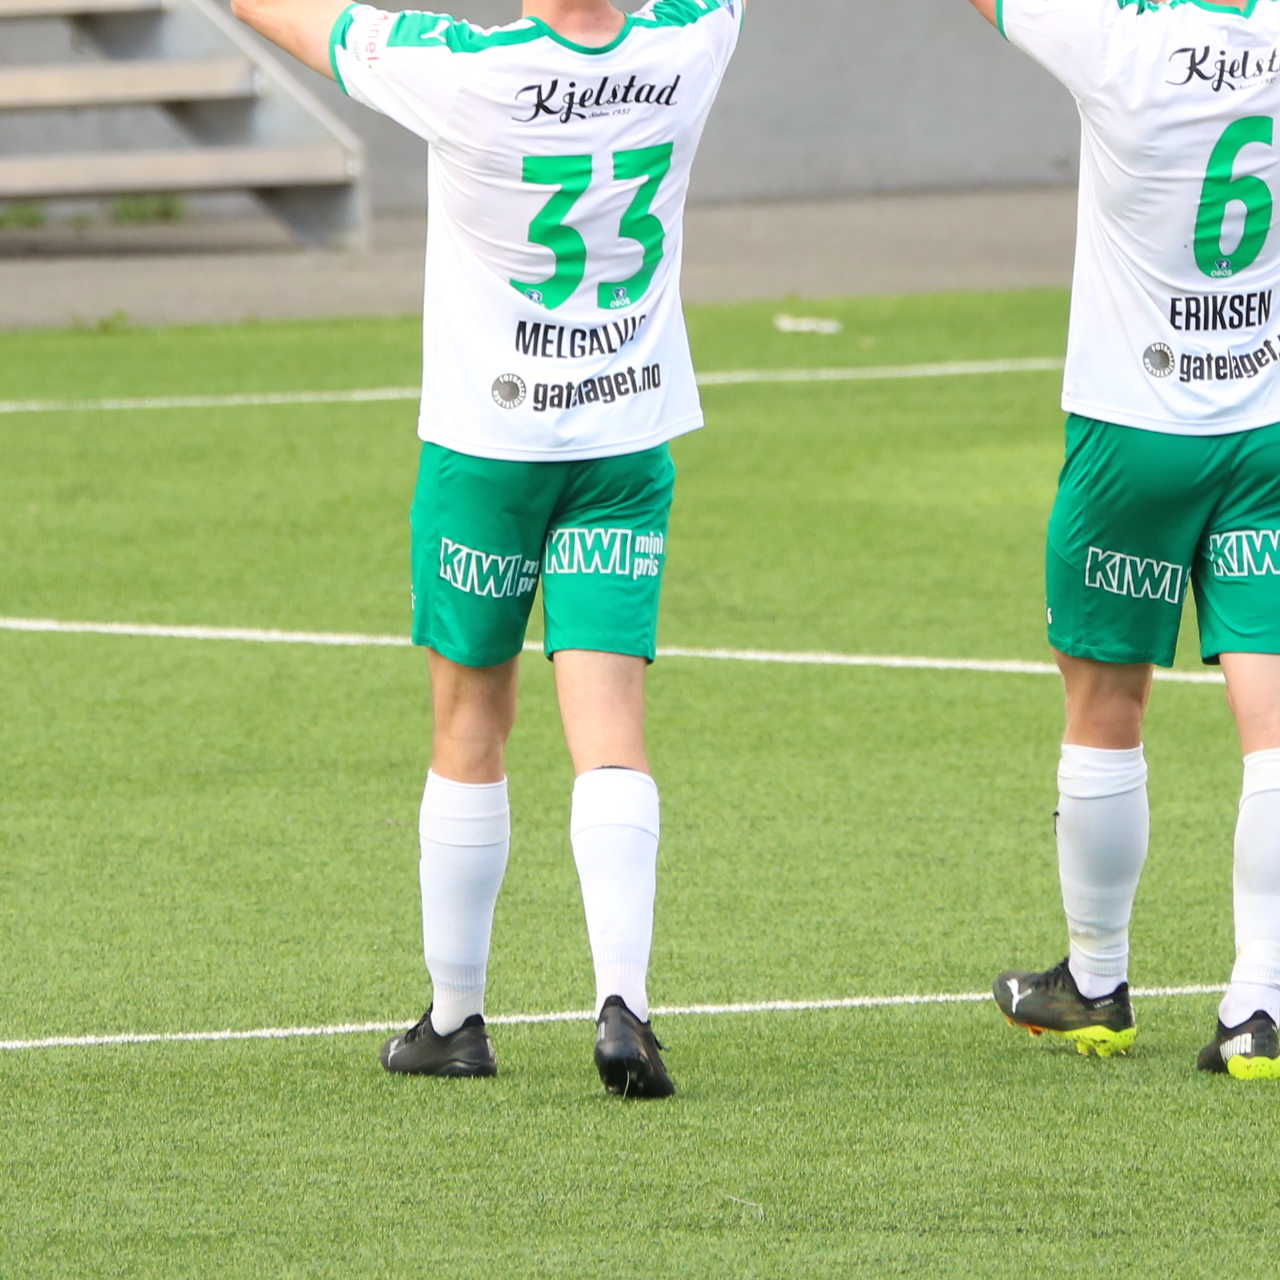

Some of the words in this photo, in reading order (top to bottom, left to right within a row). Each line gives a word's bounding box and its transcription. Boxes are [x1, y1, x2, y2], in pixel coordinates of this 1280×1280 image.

[512, 74, 682, 124] Kjelstad
[1193, 115, 1274, 279] 6
[509, 141, 674, 311] 33
[1170, 289, 1273, 332] ERIKSEN
[439, 537, 523, 599] KIWI
[544, 528, 633, 575] KIWI
[632, 554, 660, 581] pris
[634, 531, 664, 555] mini
[1084, 546, 1183, 605] KIWI
